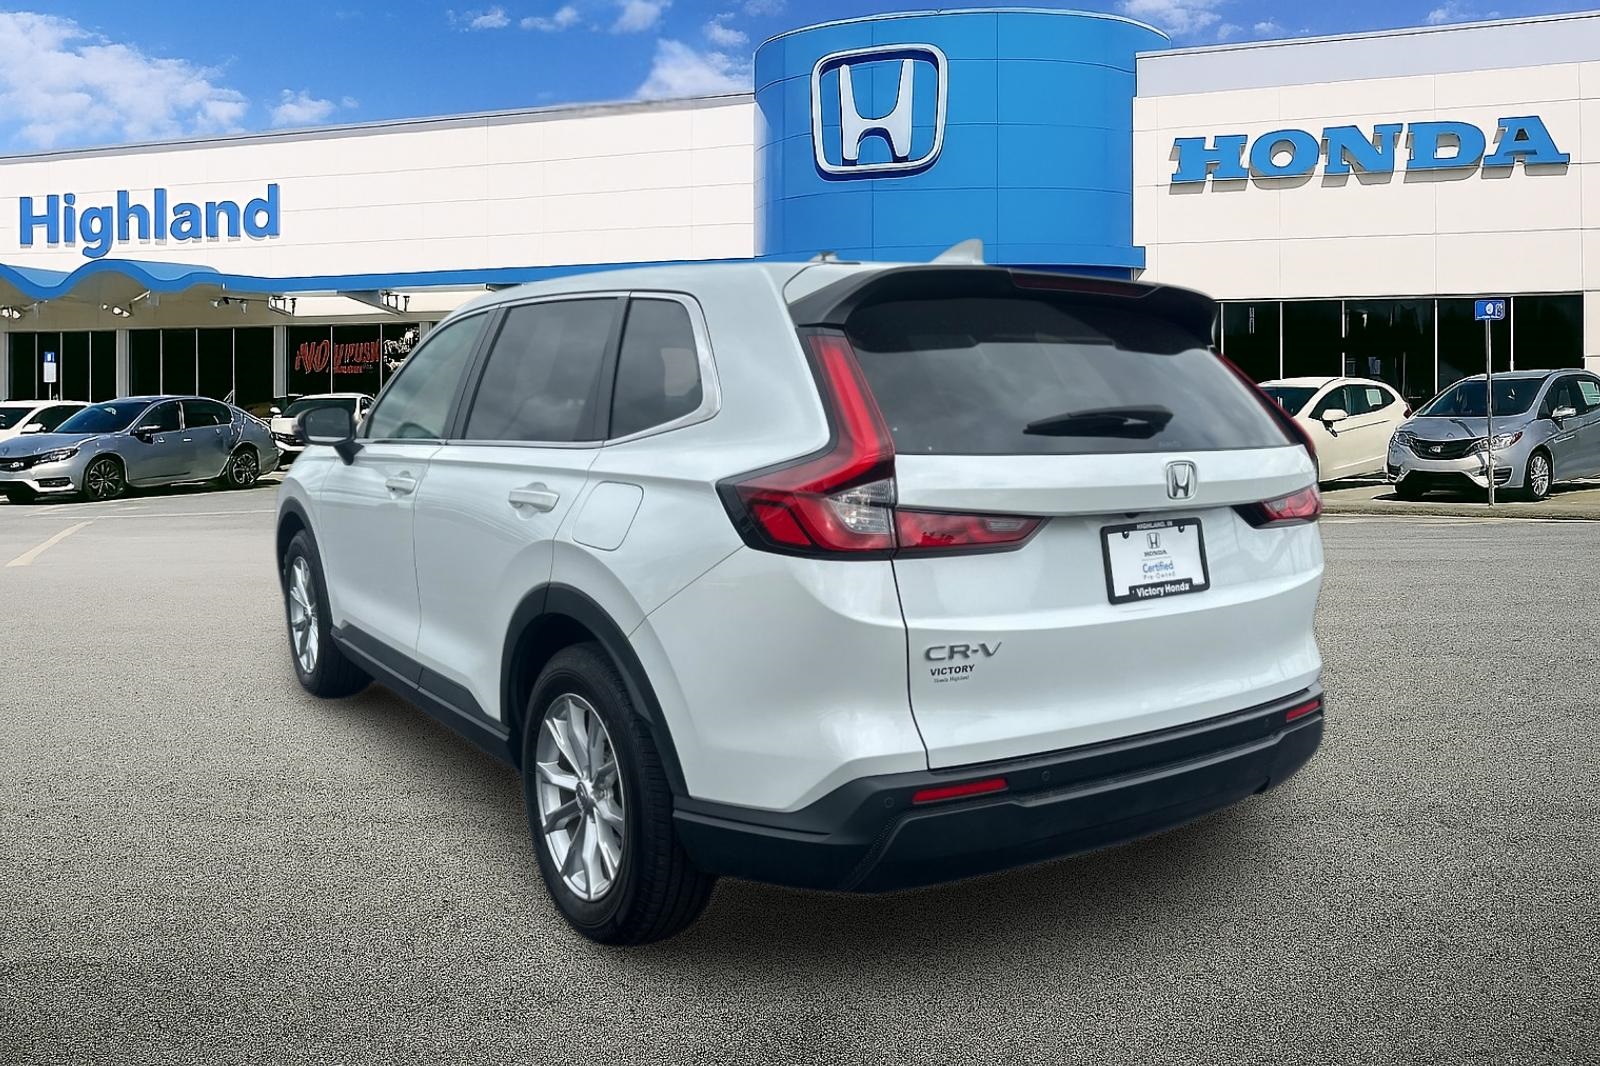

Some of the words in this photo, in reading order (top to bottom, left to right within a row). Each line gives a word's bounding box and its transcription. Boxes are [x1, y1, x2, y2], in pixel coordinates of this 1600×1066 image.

[1170, 115, 1571, 187] HONDA
[19, 183, 280, 259] Highland
[1144, 549, 1168, 557] HONDA
[1142, 560, 1174, 573] Certified
[1136, 587, 1164, 598] Victory
[1164, 582, 1190, 593] Honda
[924, 641, 1002, 661] CR-V
[930, 664, 975, 676] VICTORY
